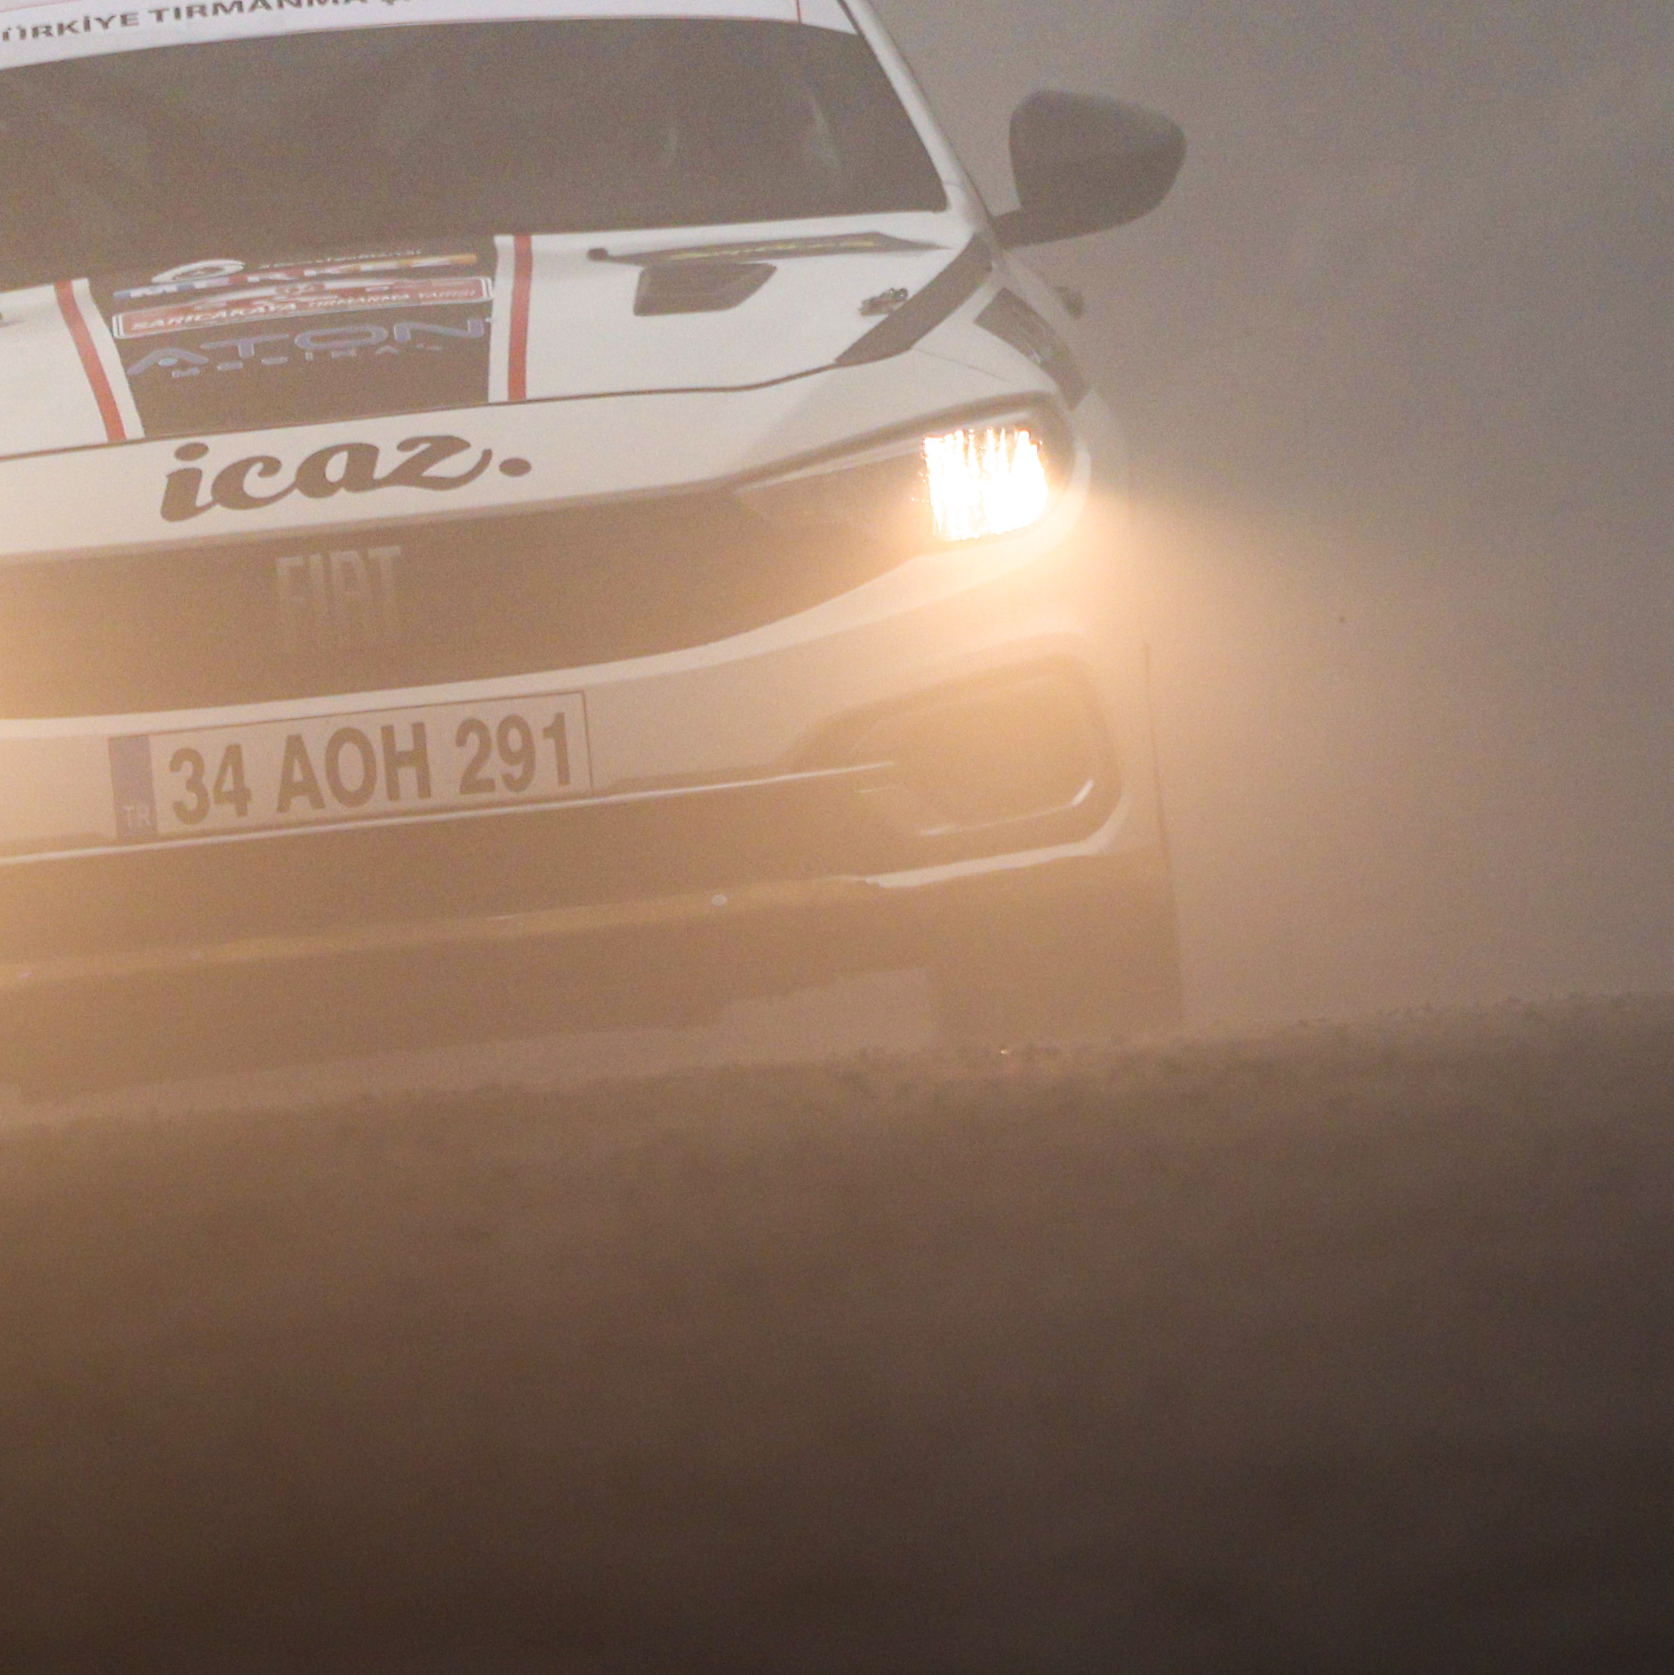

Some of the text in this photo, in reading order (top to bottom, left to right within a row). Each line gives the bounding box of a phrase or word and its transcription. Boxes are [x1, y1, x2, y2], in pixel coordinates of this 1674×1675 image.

[126, 317, 485, 376] ATON
[275, 544, 404, 643] FIAT
[168, 711, 571, 825] 34 AOH 291
[121, 804, 153, 829] TR
